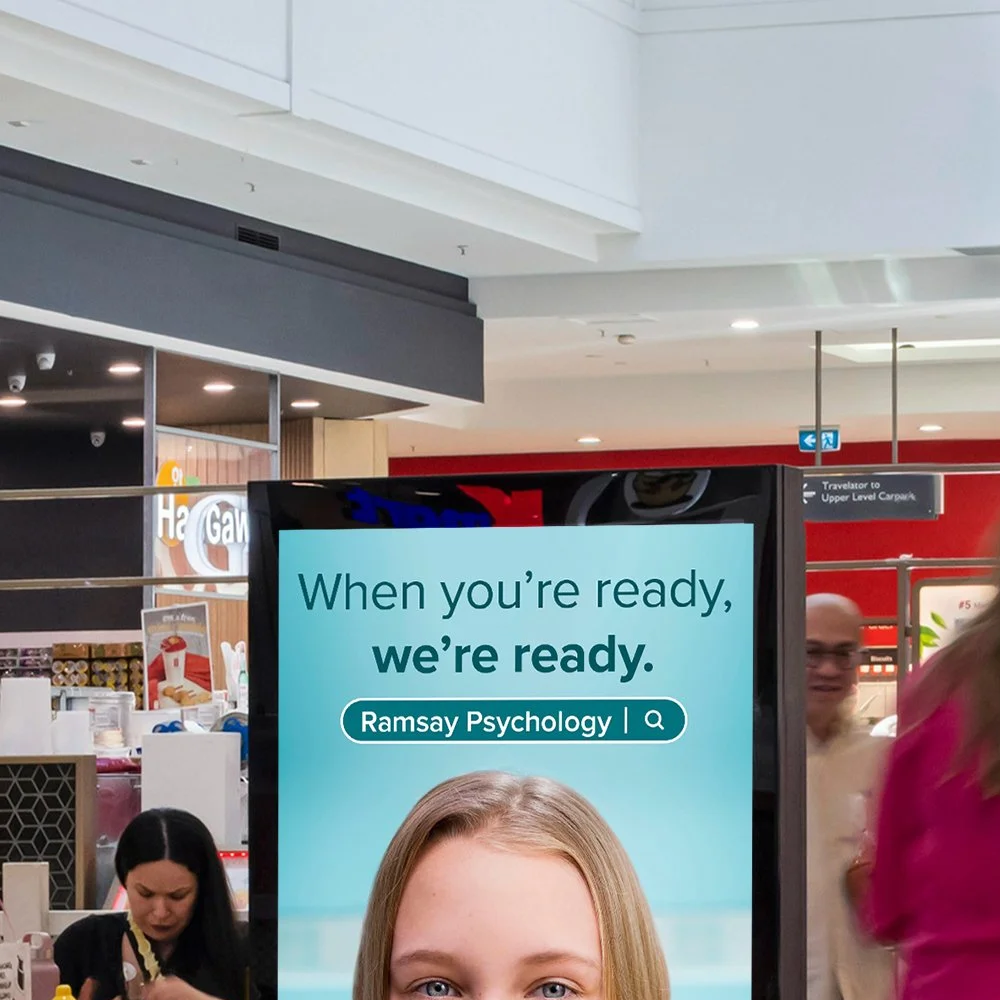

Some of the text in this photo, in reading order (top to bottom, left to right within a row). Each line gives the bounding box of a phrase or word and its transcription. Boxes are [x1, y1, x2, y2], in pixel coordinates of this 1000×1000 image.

[821, 481, 881, 490] Travelator to
[821, 491, 916, 504] Upper Level Carpark
[298, 569, 733, 619] When you’re ready,
[372, 634, 654, 682] we’re ready.
[361, 709, 613, 738] Ramsay Psychology
